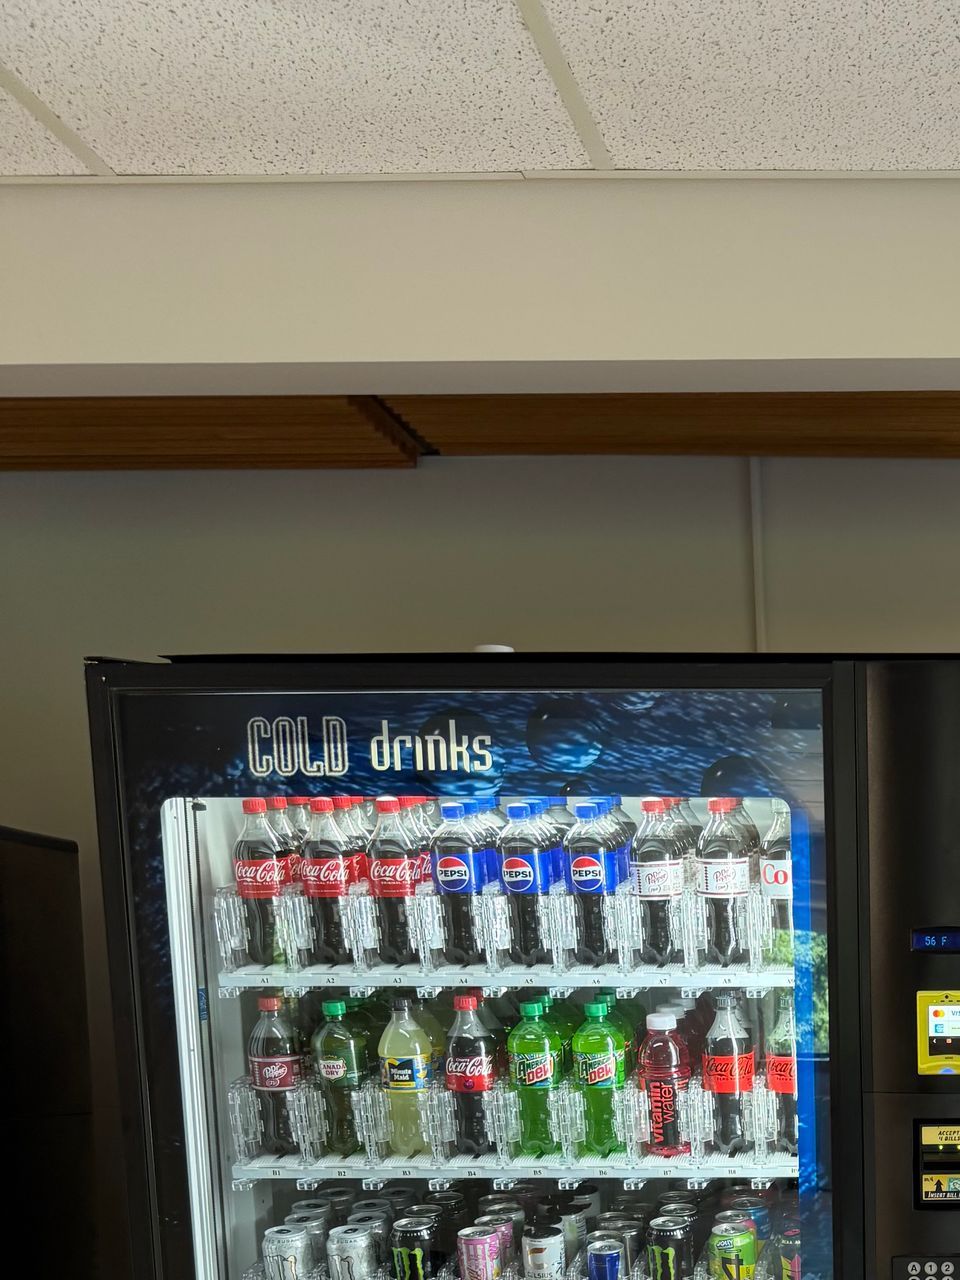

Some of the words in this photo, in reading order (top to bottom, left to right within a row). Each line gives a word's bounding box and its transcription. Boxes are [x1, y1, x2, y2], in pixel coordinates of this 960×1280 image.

[248, 716, 349, 777] COLD
[371, 719, 493, 773] drinks
[439, 869, 467, 878] PEPSI
[503, 869, 532, 878] PEPSI
[573, 869, 602, 878] PEPSI
[925, 936, 936, 946] 56
[941, 936, 947, 946] F
[393, 1073, 410, 1082] Maid
[661, 1083, 674, 1124] water
[650, 1081, 664, 1144] vitamin
